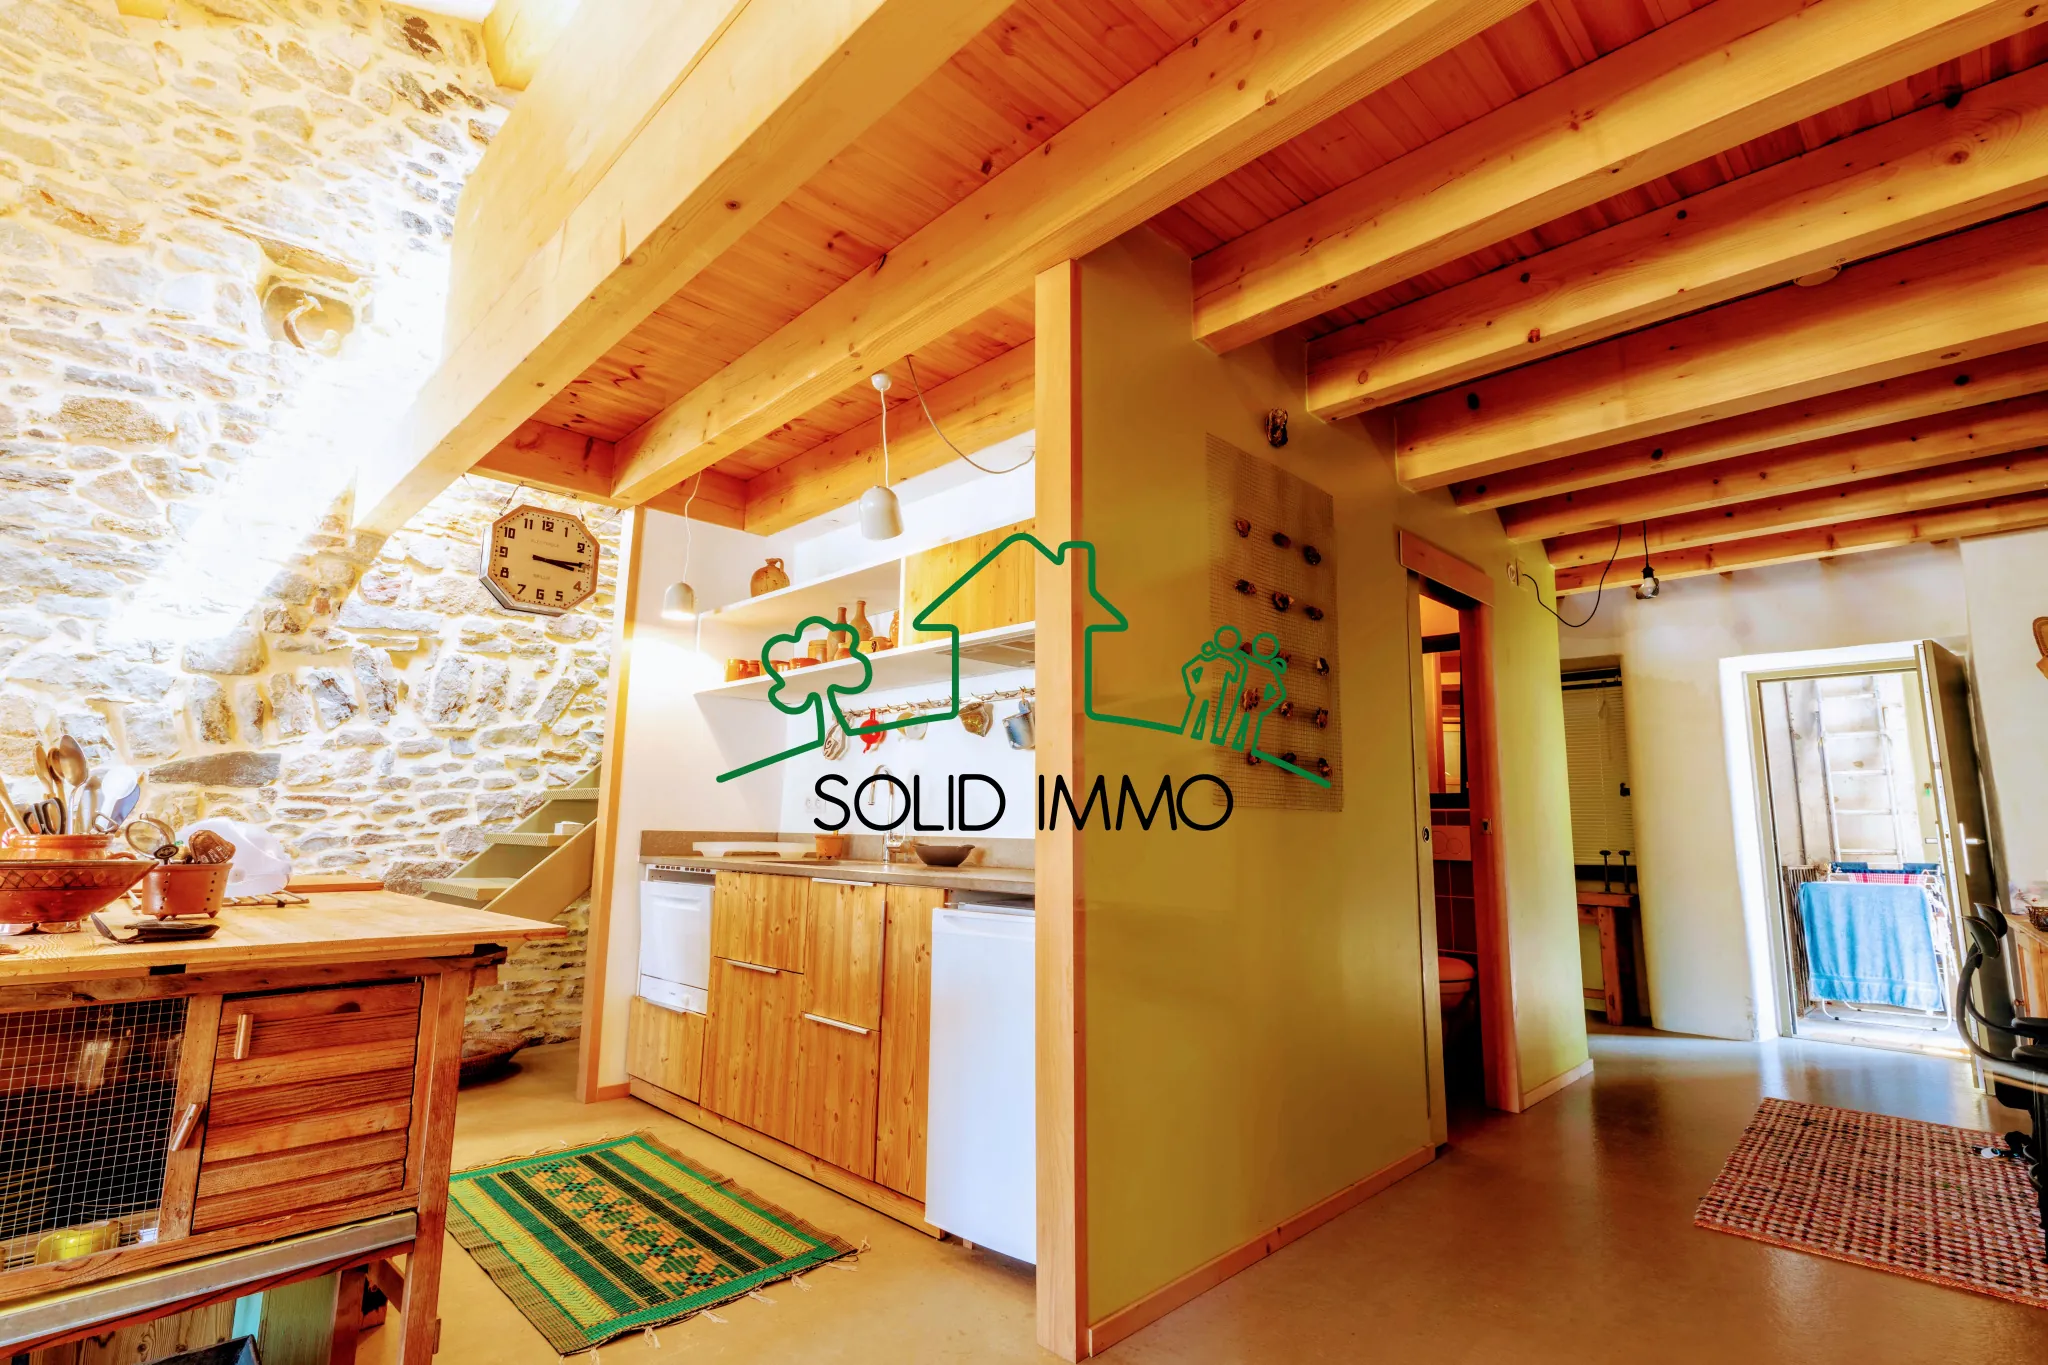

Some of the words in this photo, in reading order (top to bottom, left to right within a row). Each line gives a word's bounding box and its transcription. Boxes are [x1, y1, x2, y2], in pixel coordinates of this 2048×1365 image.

[524, 518, 534, 530] 11
[542, 520, 555, 533] 12
[504, 527, 516, 539] 10
[564, 527, 569, 538] 1
[499, 546, 508, 558] 9
[577, 542, 585, 554] 2
[500, 567, 509, 579] 8
[517, 583, 526, 594] 7
[573, 580, 582, 592] 4
[536, 588, 545, 600] 6
[555, 590, 563, 602] 5
